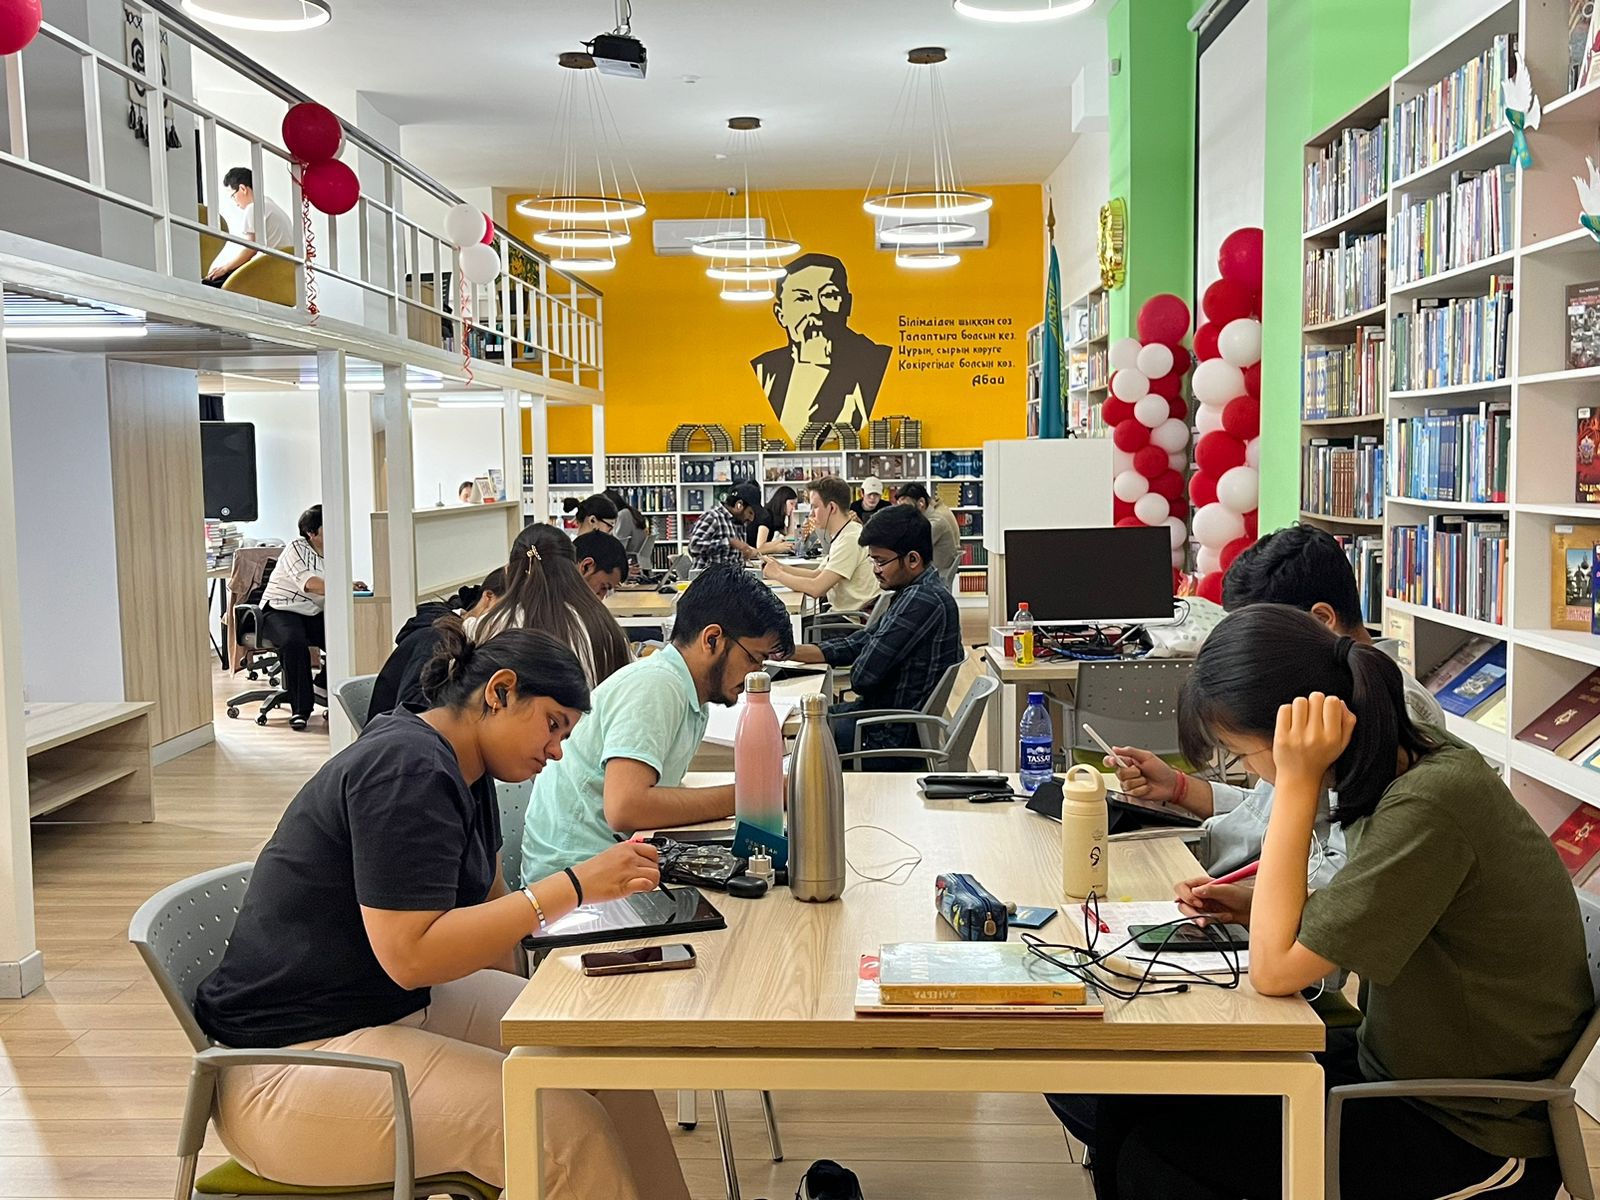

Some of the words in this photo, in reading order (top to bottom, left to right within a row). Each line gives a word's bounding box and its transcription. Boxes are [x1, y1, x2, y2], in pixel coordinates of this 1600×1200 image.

[961, 329, 996, 340] болсын
[959, 358, 994, 369] болсын
[972, 374, 1005, 387] Абай
